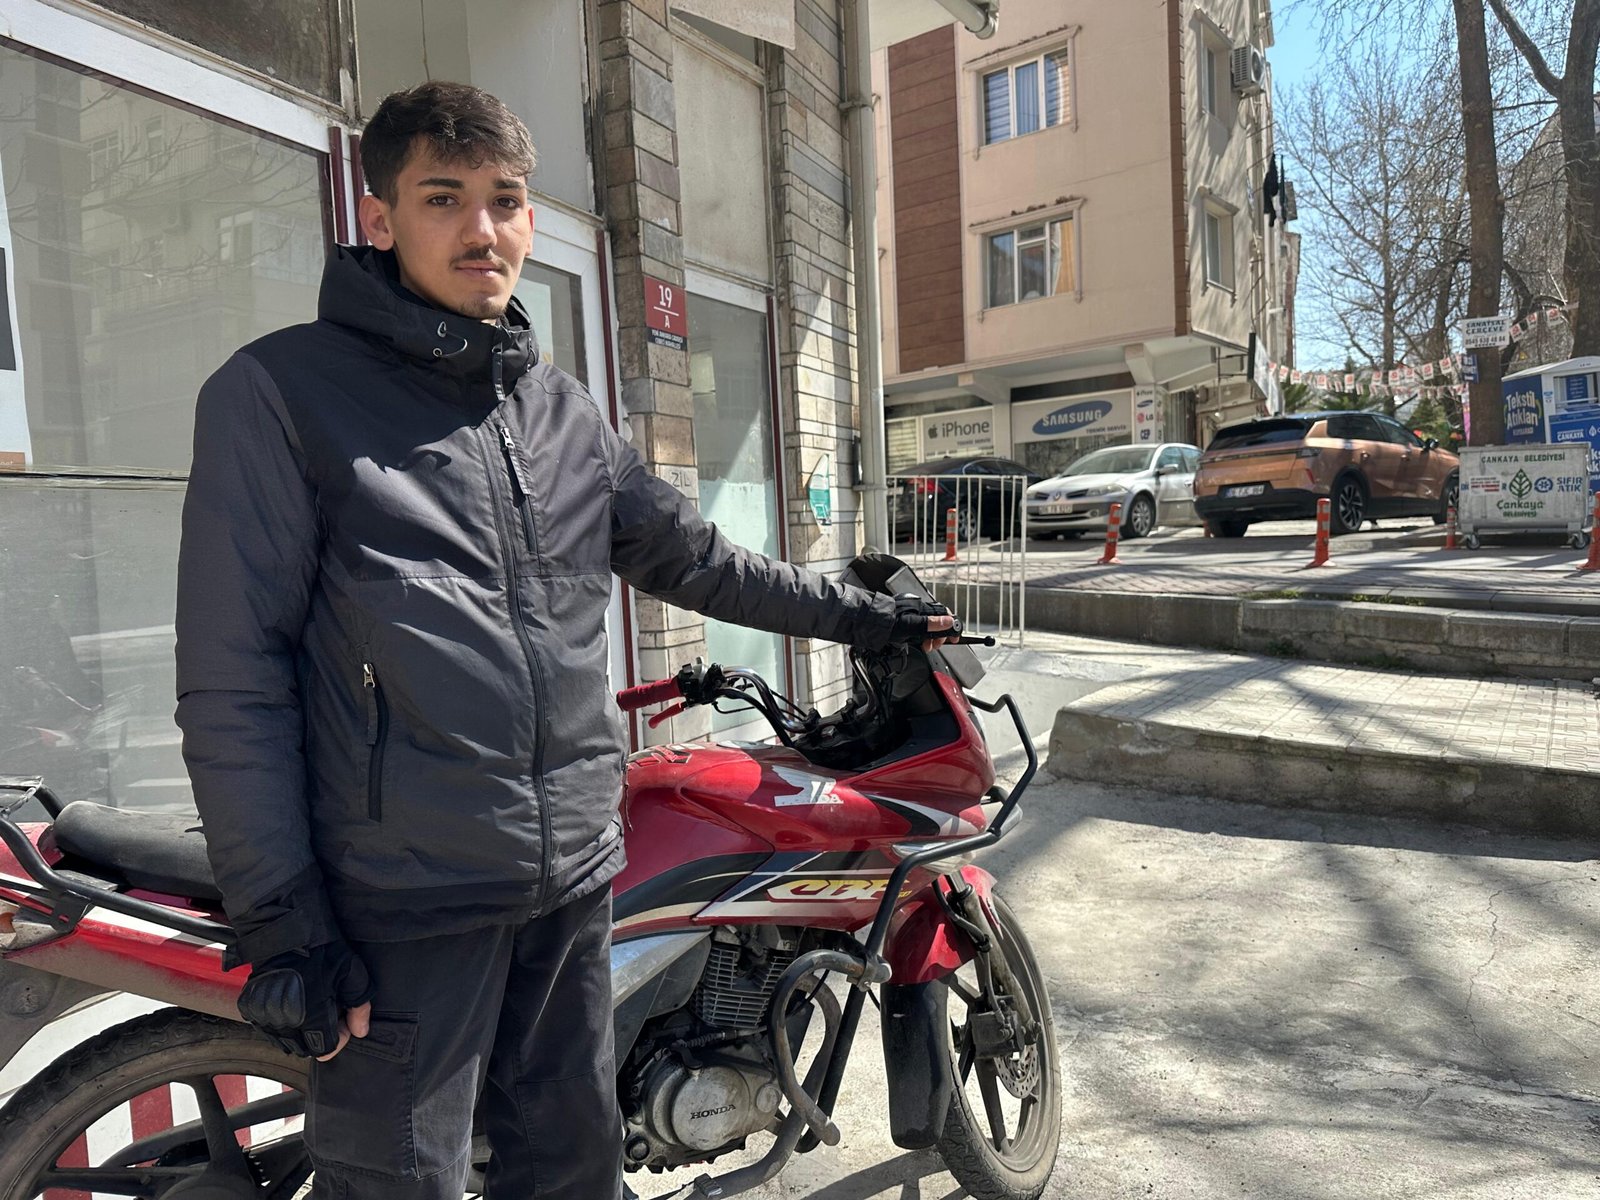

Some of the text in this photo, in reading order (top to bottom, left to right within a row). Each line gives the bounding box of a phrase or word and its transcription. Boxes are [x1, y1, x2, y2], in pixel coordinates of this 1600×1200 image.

[658, 284, 673, 309] 19
[664, 314, 671, 329] A
[1506, 390, 1536, 411] Tekstil
[1042, 409, 1102, 427] SAMSUNG
[942, 420, 990, 438] iPhone
[1481, 452, 1566, 464] ÇANKAYA BELEDİYESİ
[1556, 477, 1583, 485] SIFIR
[1557, 484, 1581, 492] ATIK
[1496, 500, 1544, 511] Çankaya
[690, 1104, 737, 1120] HONDA
